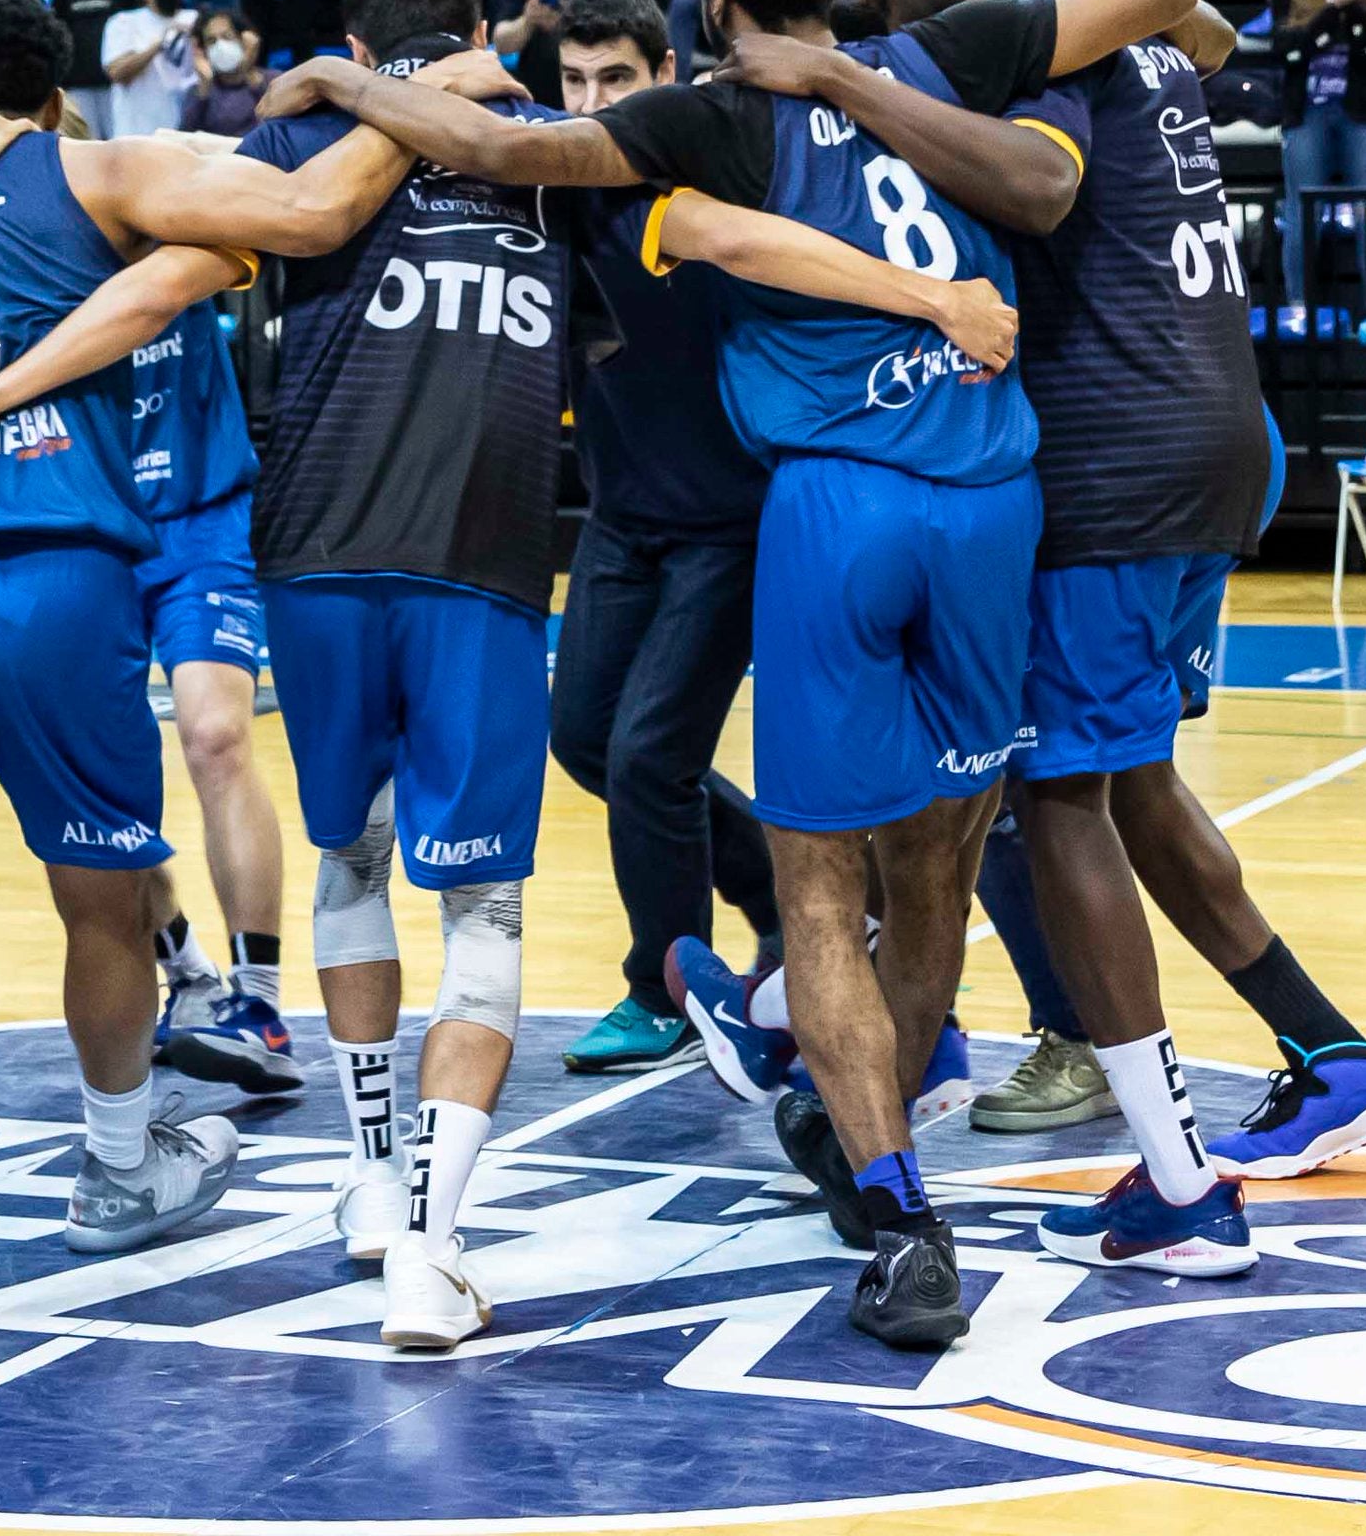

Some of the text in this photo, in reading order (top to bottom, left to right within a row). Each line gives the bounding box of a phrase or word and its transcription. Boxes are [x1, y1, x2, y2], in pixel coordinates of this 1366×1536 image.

[862, 154, 958, 282] 8
[364, 257, 553, 348] OTIS
[350, 1053, 393, 1159] ELITE
